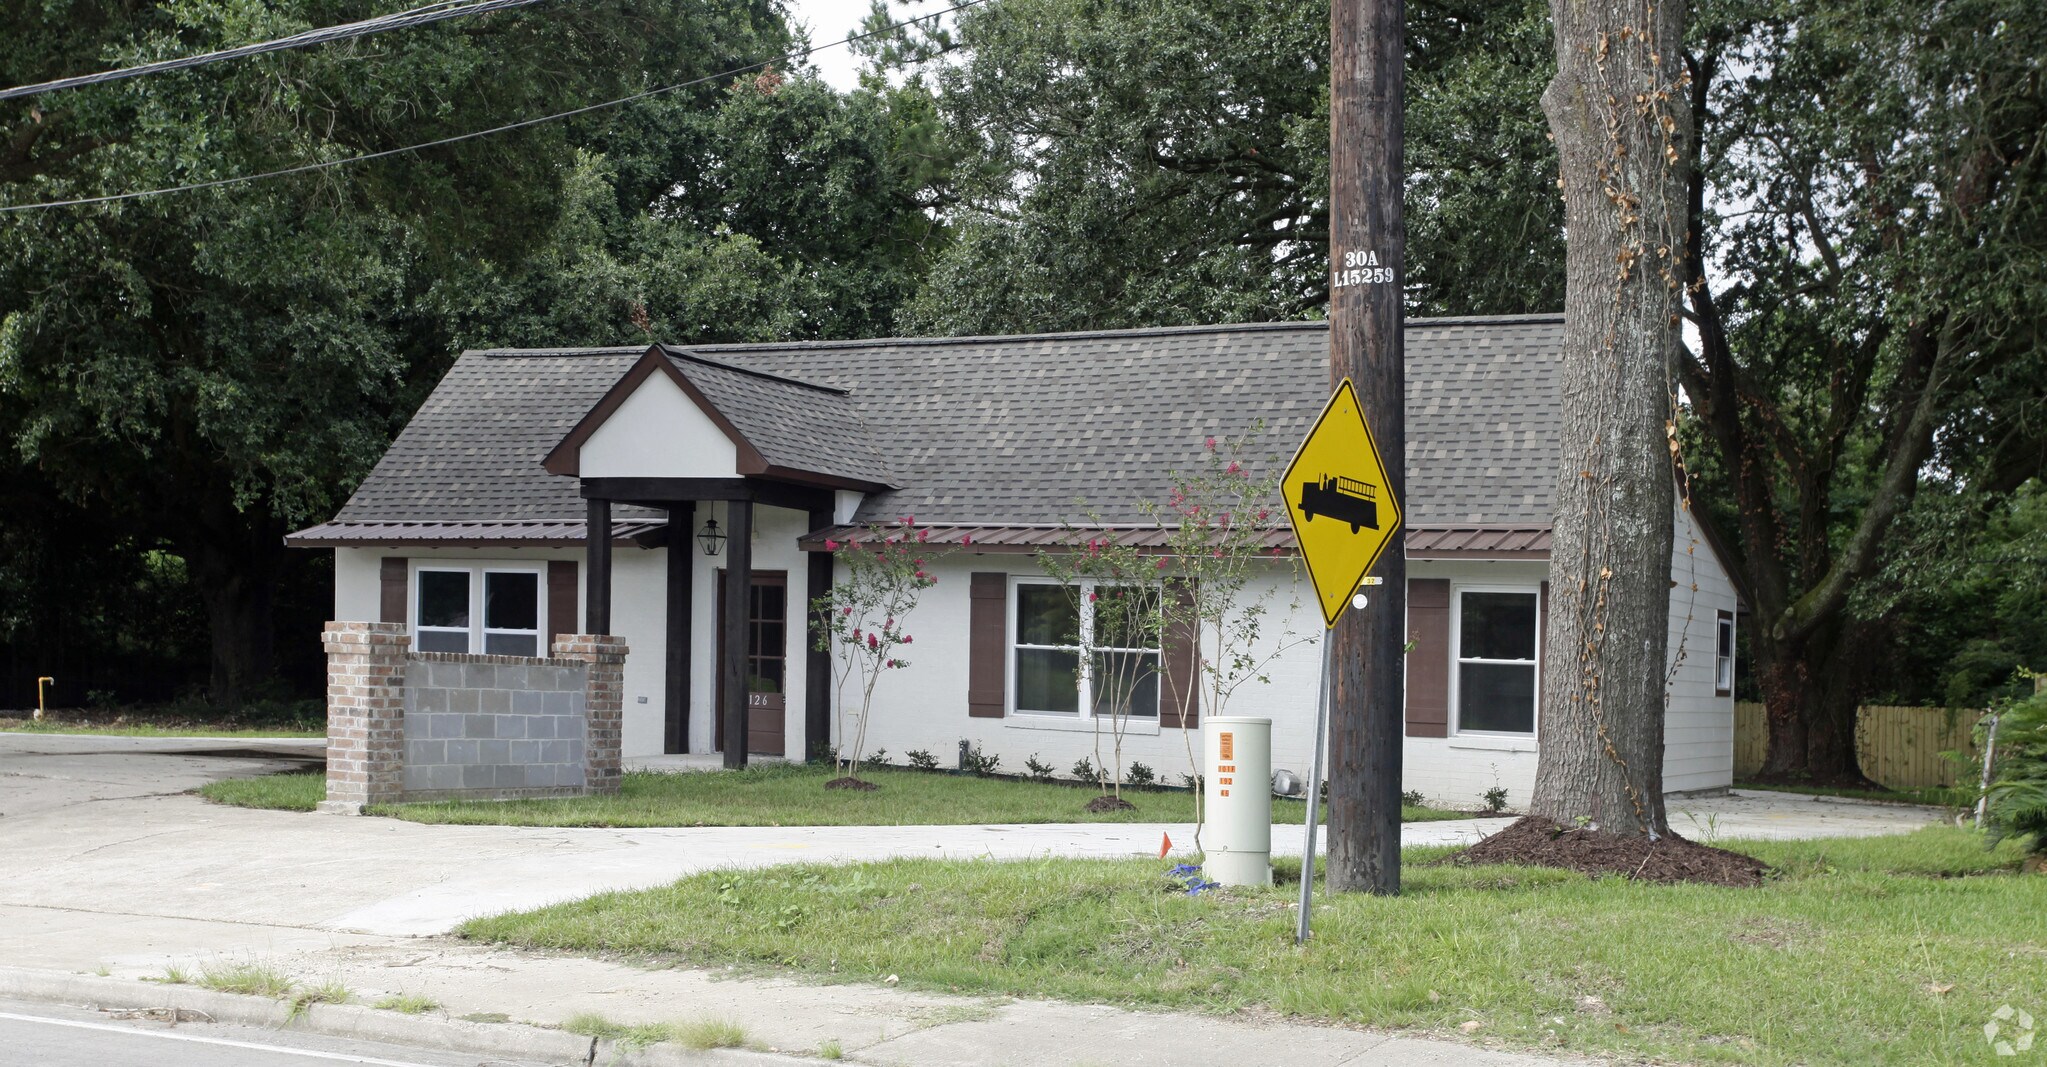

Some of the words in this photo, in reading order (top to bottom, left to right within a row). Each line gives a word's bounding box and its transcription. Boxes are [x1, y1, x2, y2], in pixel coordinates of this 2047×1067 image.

[1345, 250, 1379, 267] 30A
[1334, 267, 1394, 287] L15259
[749, 695, 768, 706] 126
